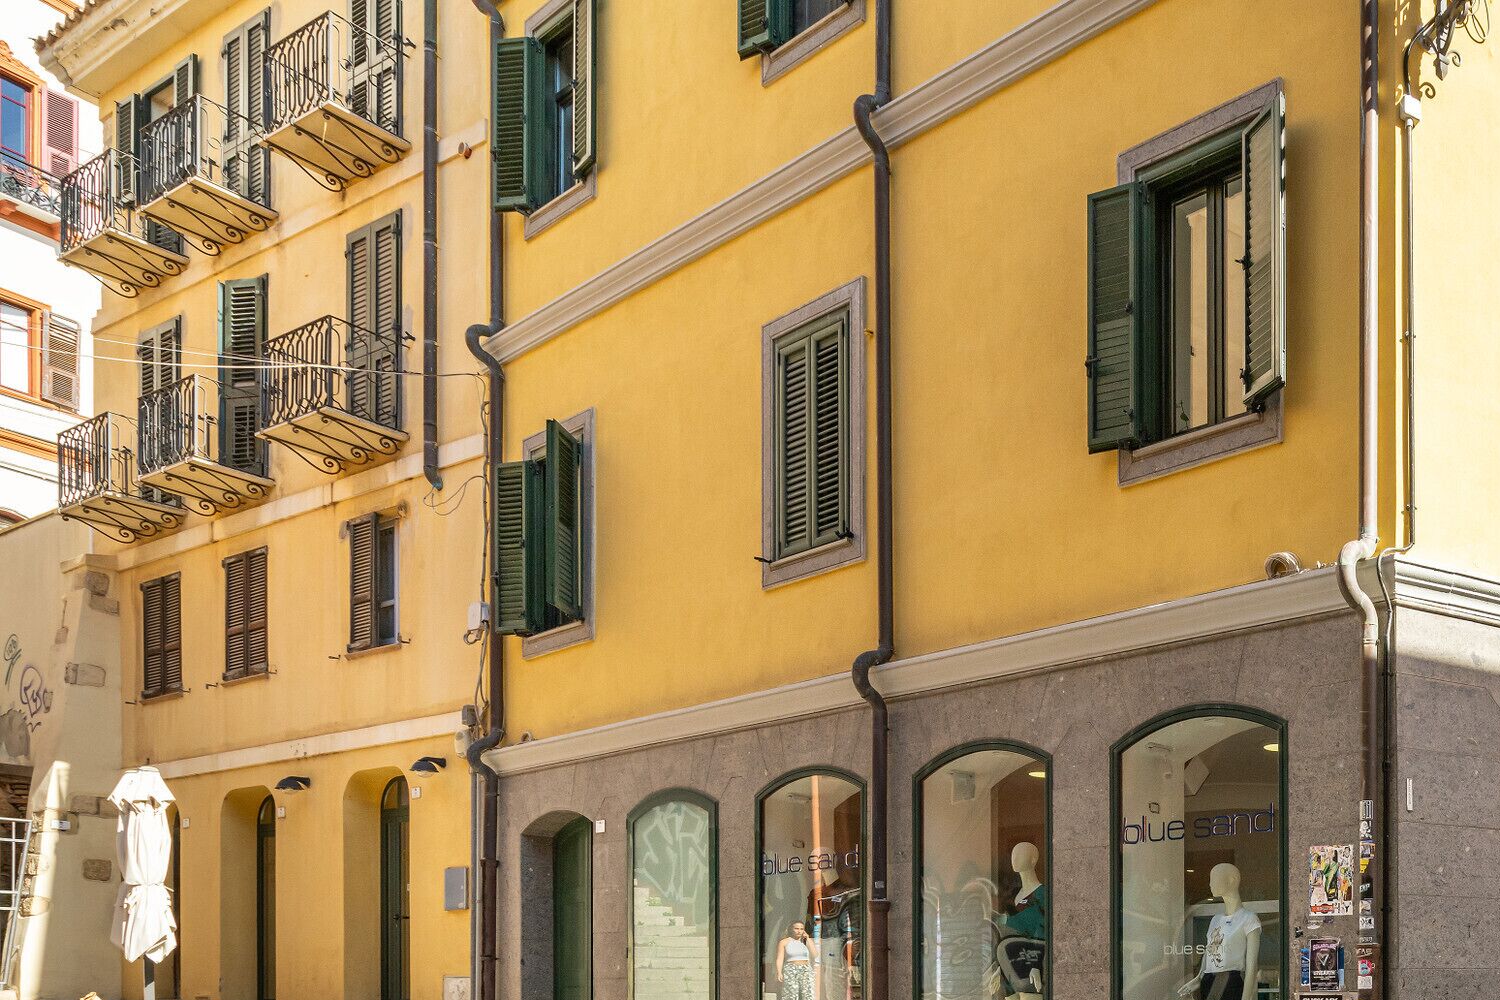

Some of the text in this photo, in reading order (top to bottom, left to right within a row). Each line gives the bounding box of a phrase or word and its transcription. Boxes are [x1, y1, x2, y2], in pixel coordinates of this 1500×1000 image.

[1123, 802, 1275, 844] blue sand
[762, 851, 803, 876] blue
[1163, 942, 1193, 955] blue
